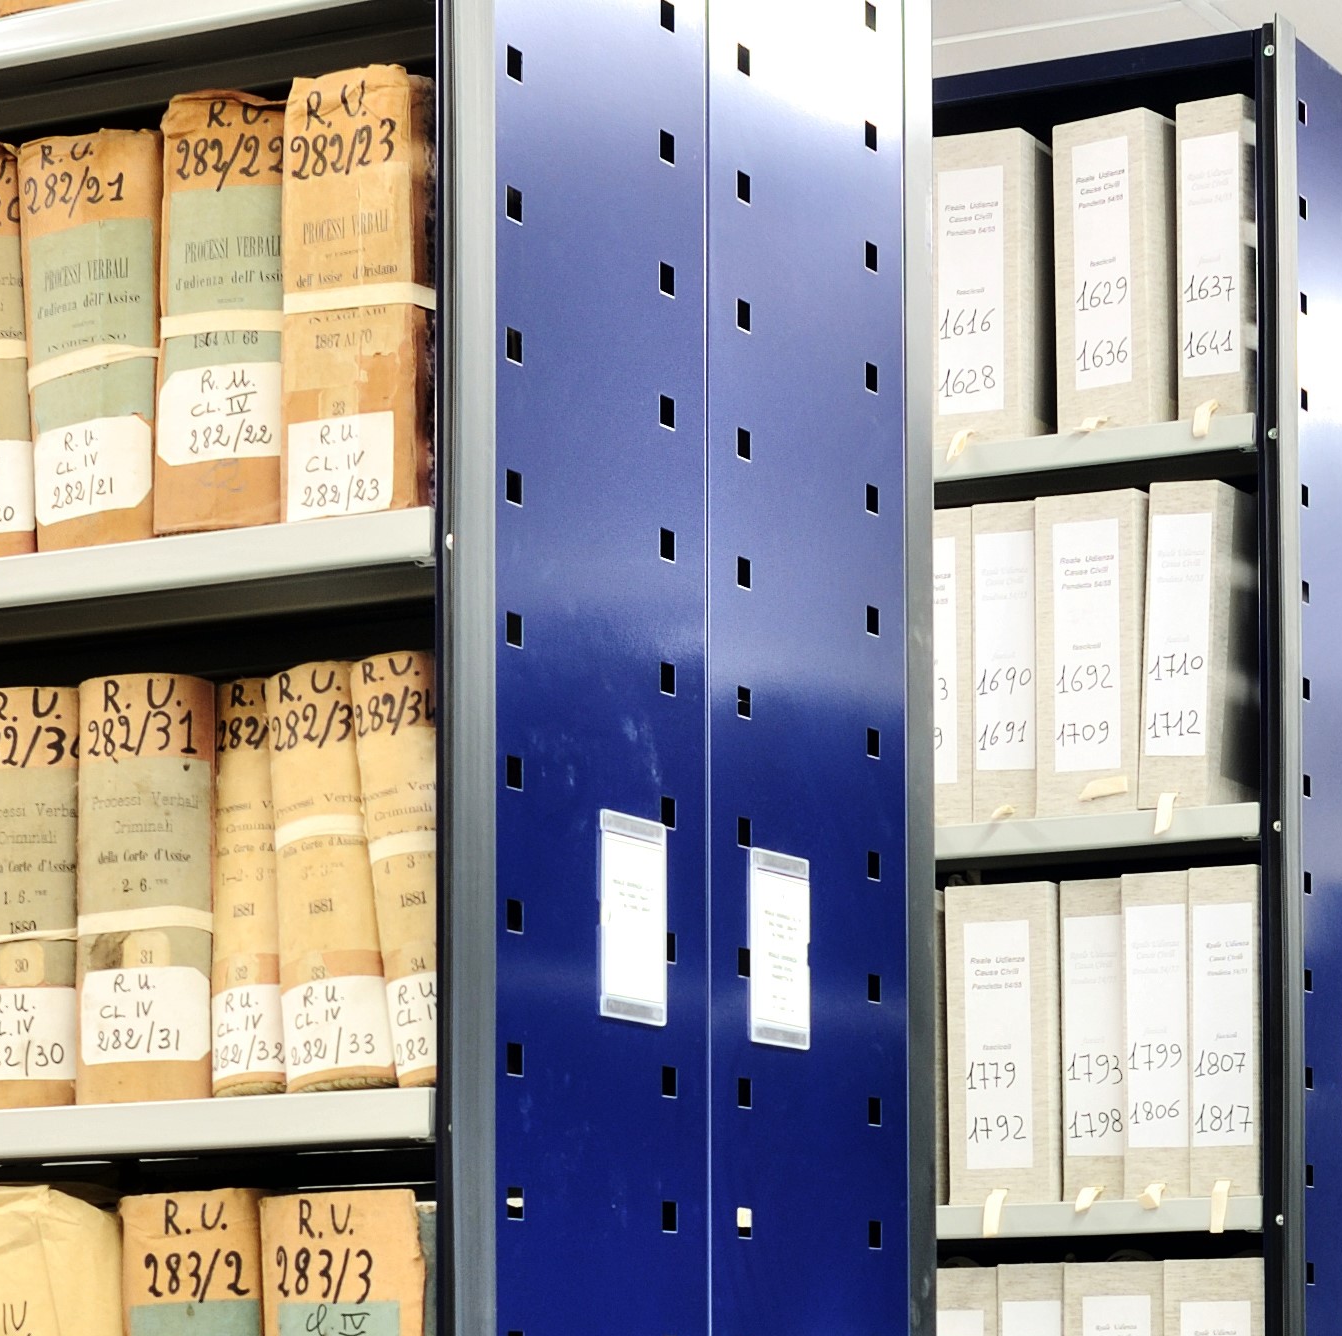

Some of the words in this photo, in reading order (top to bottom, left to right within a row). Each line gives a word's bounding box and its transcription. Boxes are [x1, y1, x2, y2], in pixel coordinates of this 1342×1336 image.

[290, 118, 397, 182] 282/23
[23, 169, 125, 220] 282/21
[184, 241, 228, 264] PROCESSI
[43, 264, 81, 291] PROCESSI
[87, 258, 130, 282] VERBALI
[1184, 274, 1235, 302] 1637
[107, 291, 140, 308] Assise
[1076, 276, 1127, 311] 1629
[940, 308, 995, 340] 1616
[1076, 337, 1127, 371] 1636
[1184, 329, 1233, 359] 1641
[939, 365, 995, 397] 1628
[189, 422, 273, 459] 282/22
[53, 476, 114, 511] 282/21
[301, 476, 380, 508] 282/23
[977, 666, 1031, 696] 1690
[1057, 665, 1113, 694] 1692
[1149, 653, 1203, 681] 1710
[87, 710, 196, 760] 282/31
[979, 721, 1026, 750] 1691
[1057, 721, 1109, 747] 1709
[1149, 709, 1201, 738] 1712
[401, 892, 427, 907] 1881
[140, 950, 153, 963] 31
[410, 958, 427, 970] 34
[97, 1022, 181, 1054] 282/31
[1068, 1053, 1123, 1084] 1793
[1128, 1042, 1182, 1071] 1799
[1195, 1052, 1246, 1077] 1807
[967, 1062, 1015, 1090] 1779
[1069, 1108, 1123, 1138] 1798
[1130, 1100, 1179, 1124] 1806
[1195, 1104, 1252, 1134] 1817
[968, 1116, 1026, 1143] 1792
[145, 1249, 249, 1302] 283/2
[277, 1245, 372, 1304] 283/3
